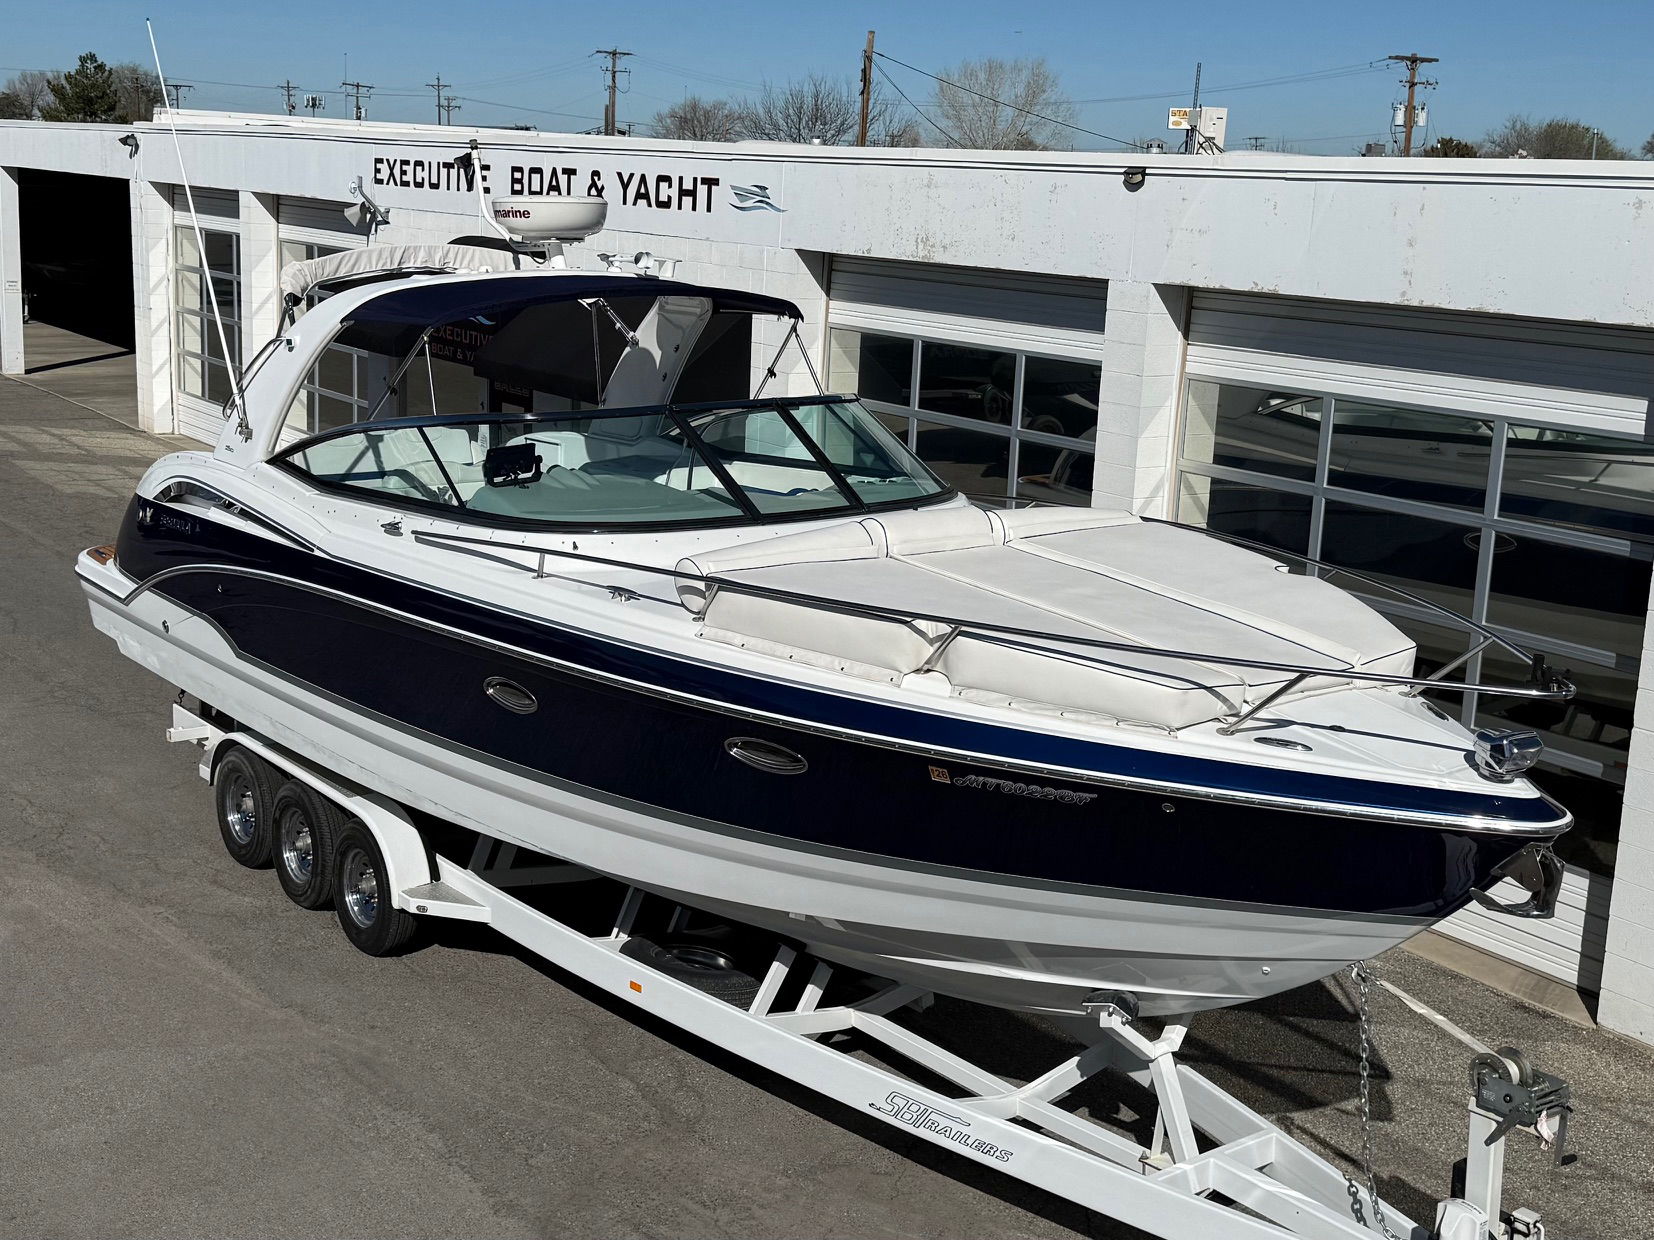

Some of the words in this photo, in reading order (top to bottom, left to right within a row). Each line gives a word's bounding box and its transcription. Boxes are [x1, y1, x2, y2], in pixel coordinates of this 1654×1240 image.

[510, 165, 577, 196] BOAT
[586, 169, 605, 200] &
[615, 171, 720, 214] YACHT
[431, 342, 454, 358] BOAT
[456, 348, 463, 360] &
